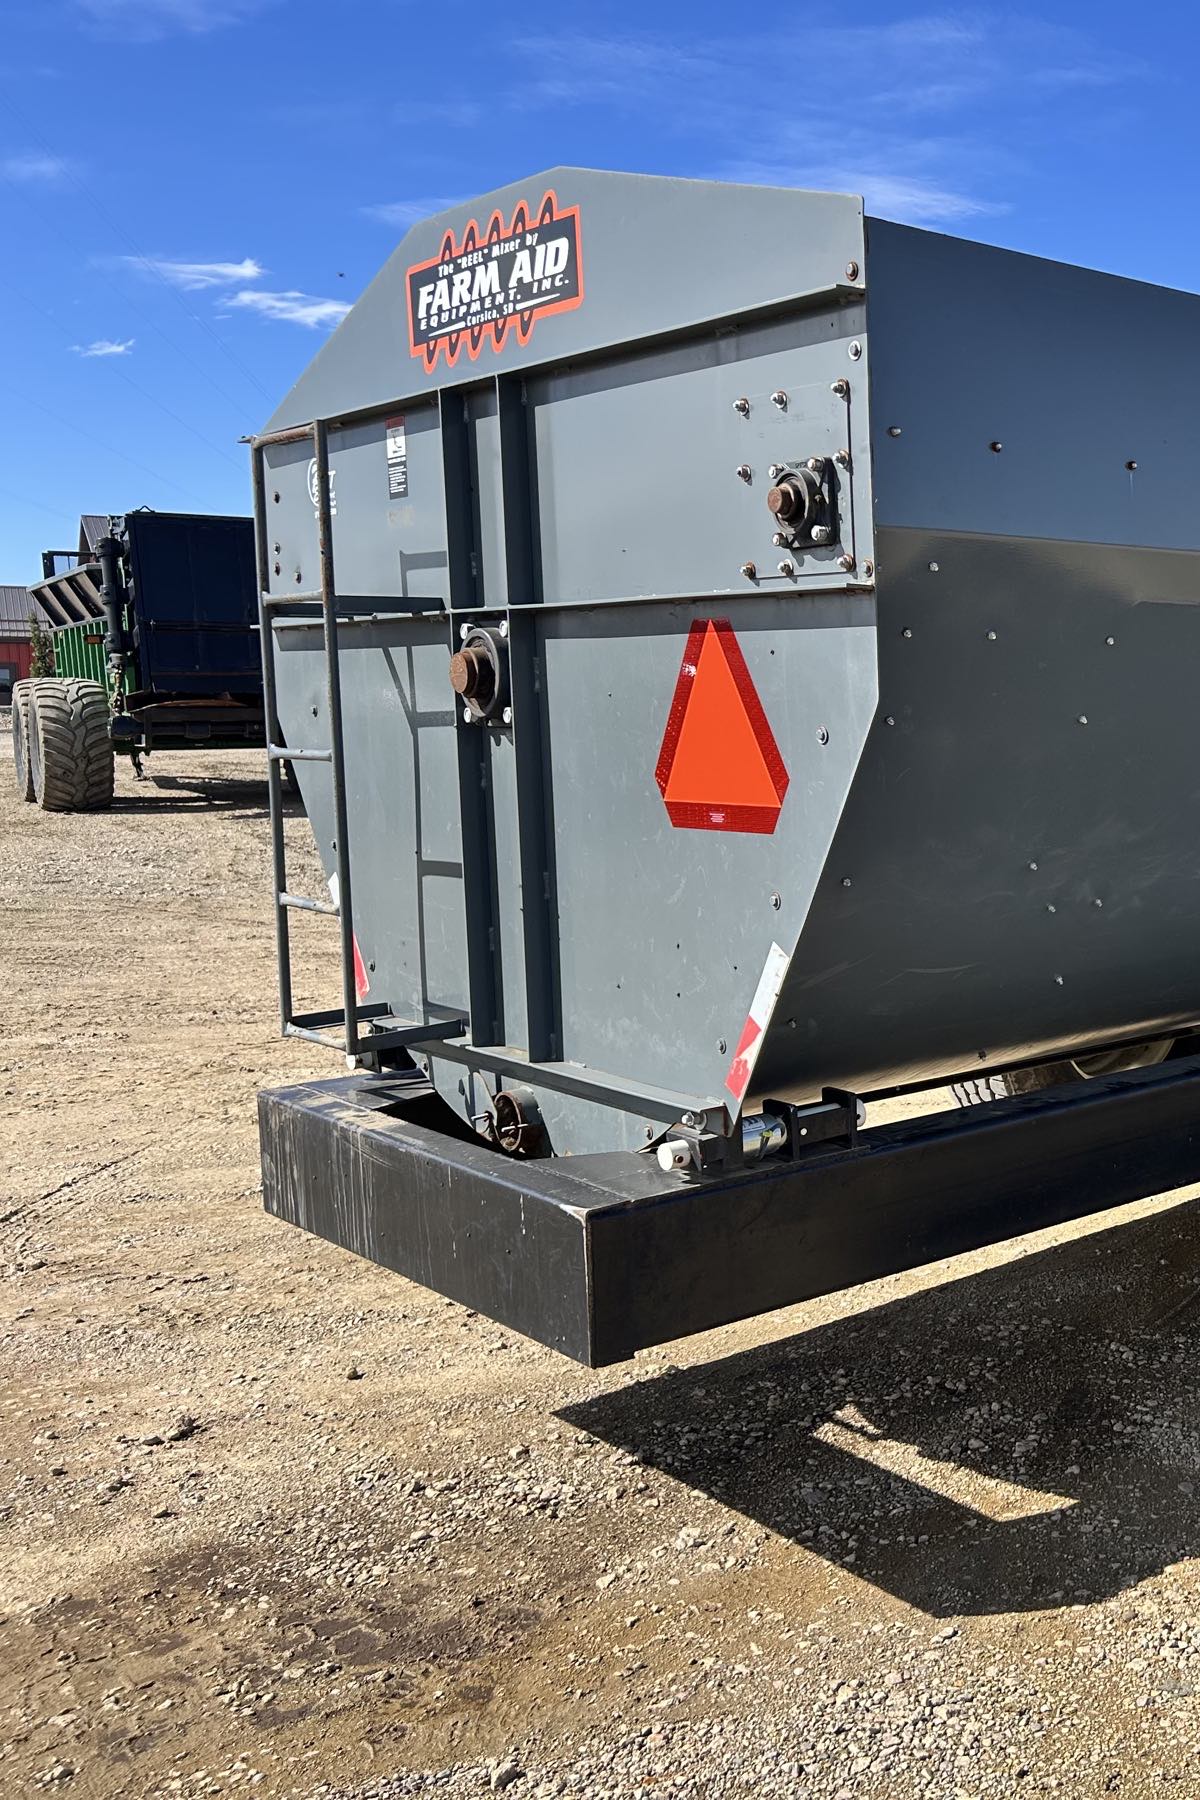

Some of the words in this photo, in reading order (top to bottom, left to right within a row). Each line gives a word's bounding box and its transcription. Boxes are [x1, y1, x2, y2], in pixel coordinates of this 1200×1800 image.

[417, 260, 501, 319] FARM
[508, 237, 569, 288] AID
[438, 263, 454, 278] The
[491, 239, 521, 258] Mixer
[525, 232, 539, 246] by
[532, 274, 570, 294] INC.
